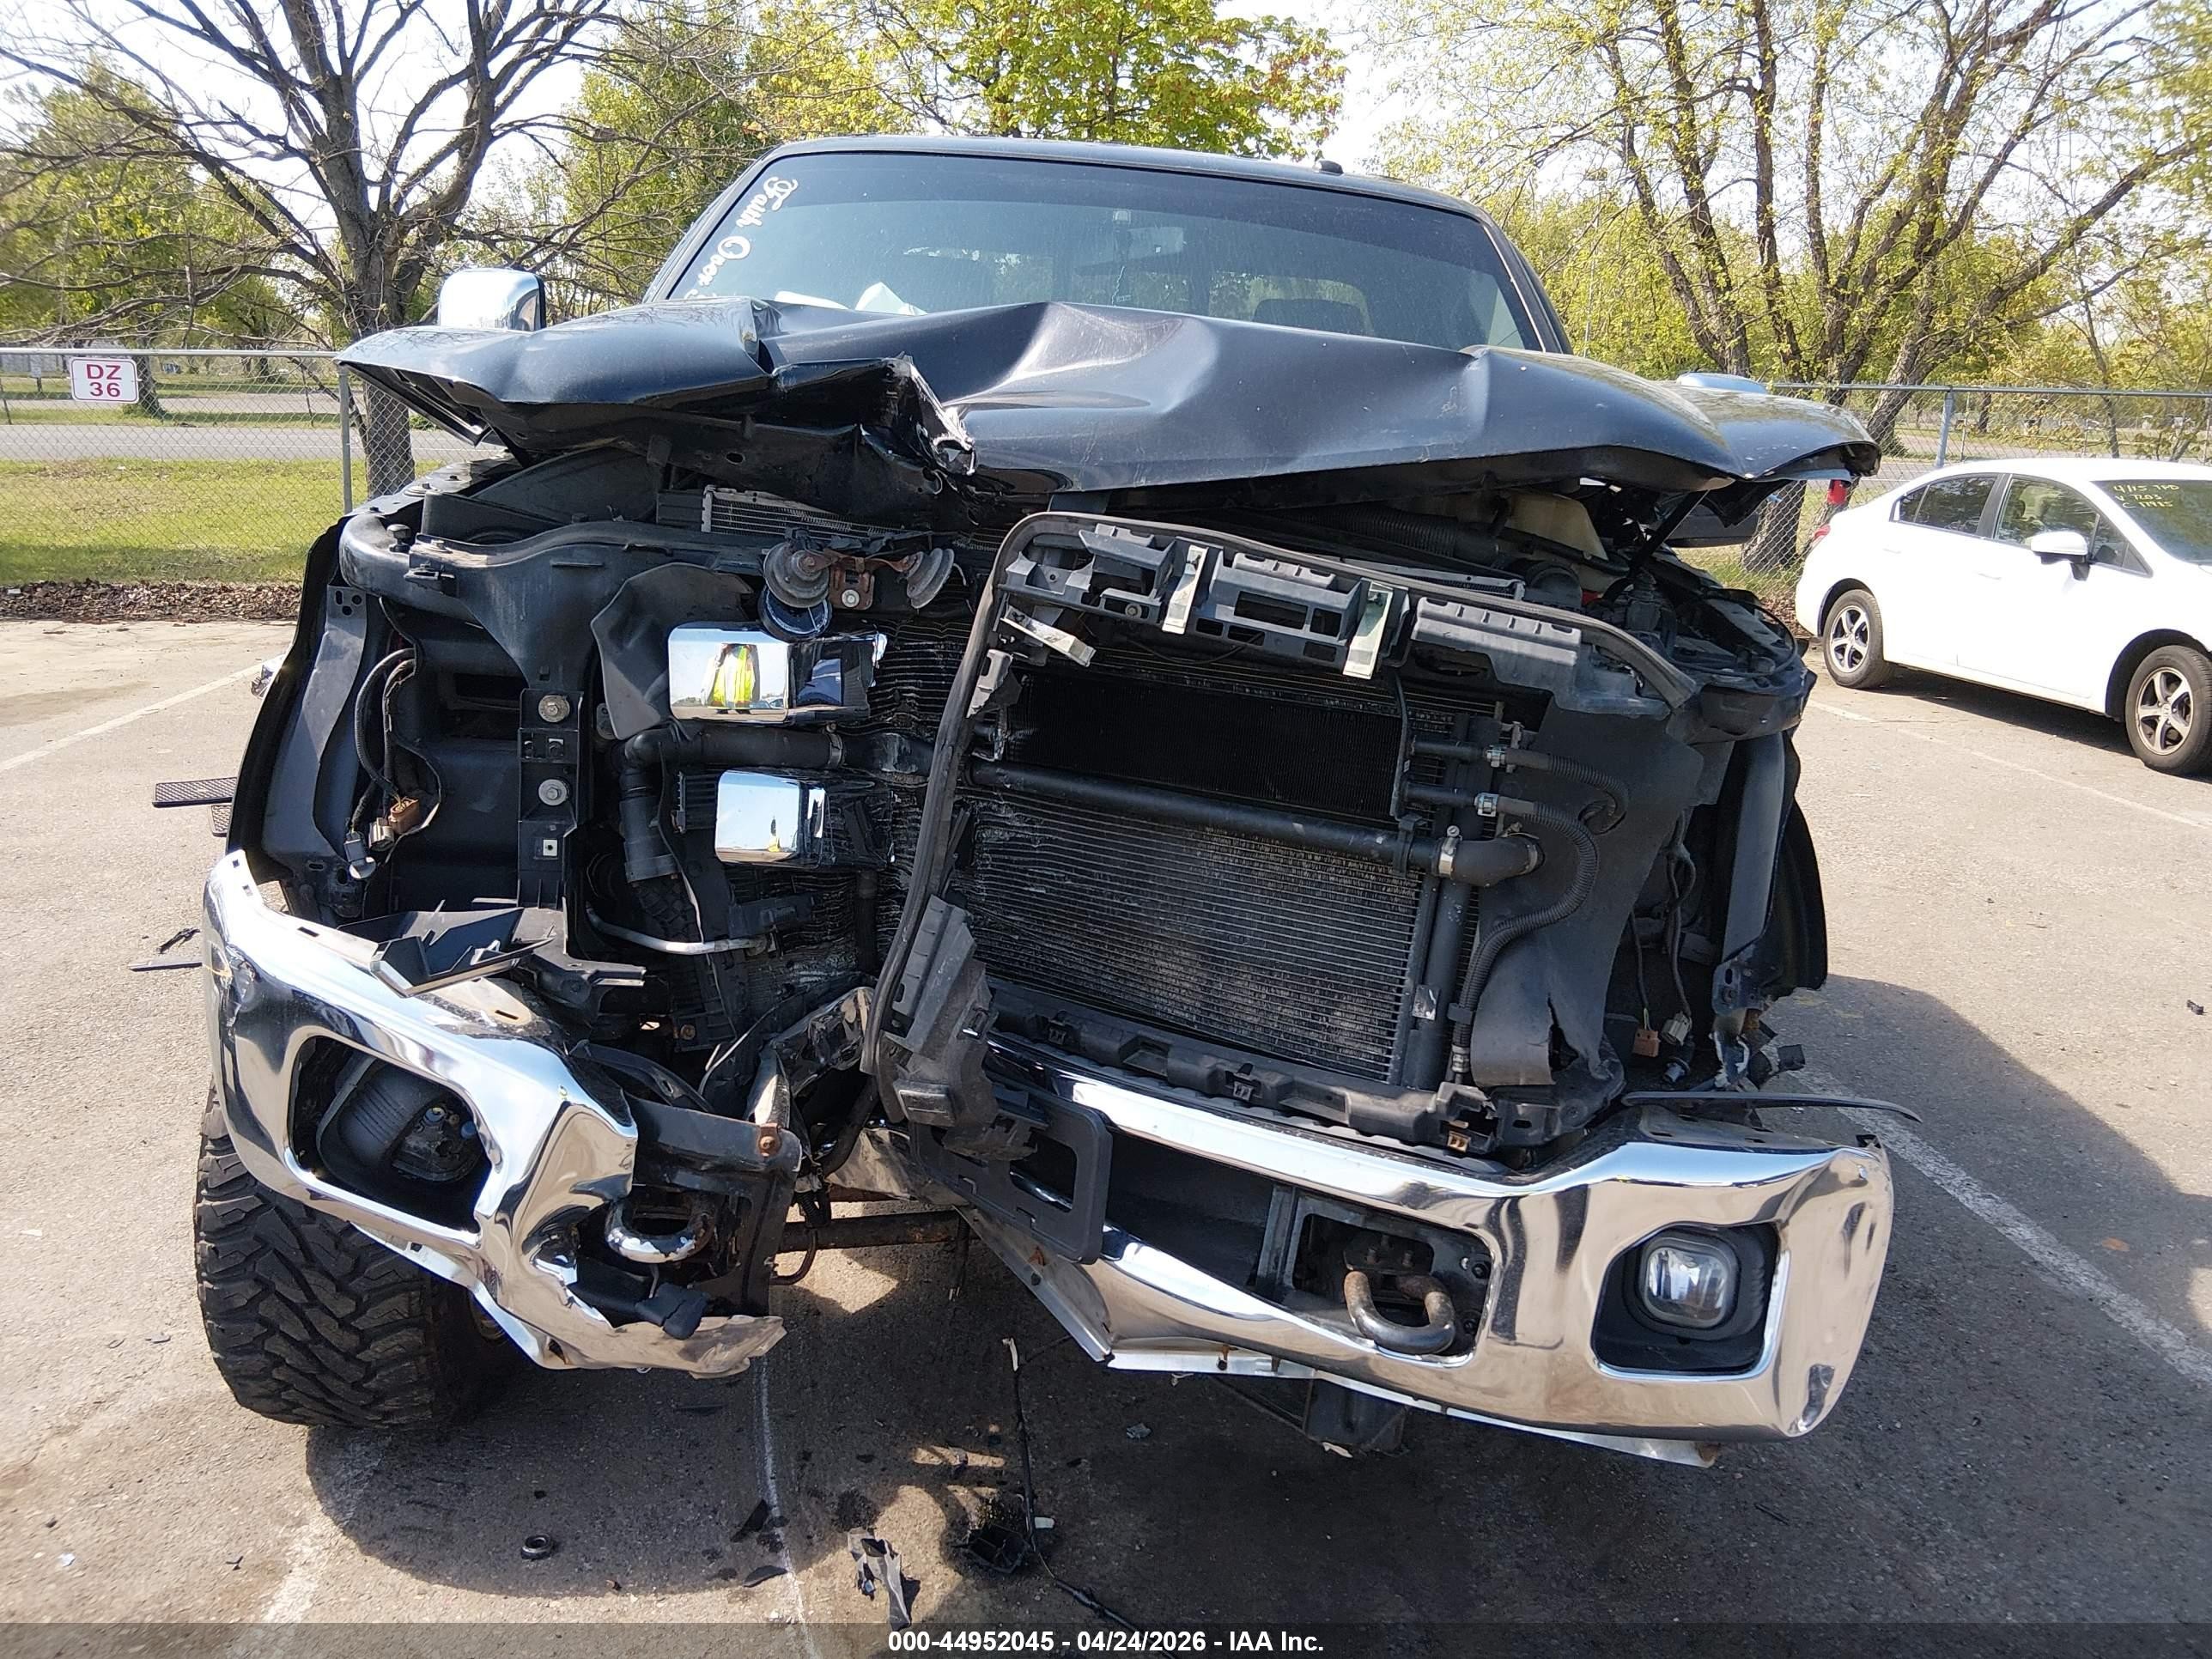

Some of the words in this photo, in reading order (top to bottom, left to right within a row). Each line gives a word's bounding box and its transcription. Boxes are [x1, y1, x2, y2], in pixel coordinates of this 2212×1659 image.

[736, 176, 799, 228] Faith
[697, 235, 751, 286] Over
[86, 363, 122, 380] DZ
[89, 381, 121, 398] 36
